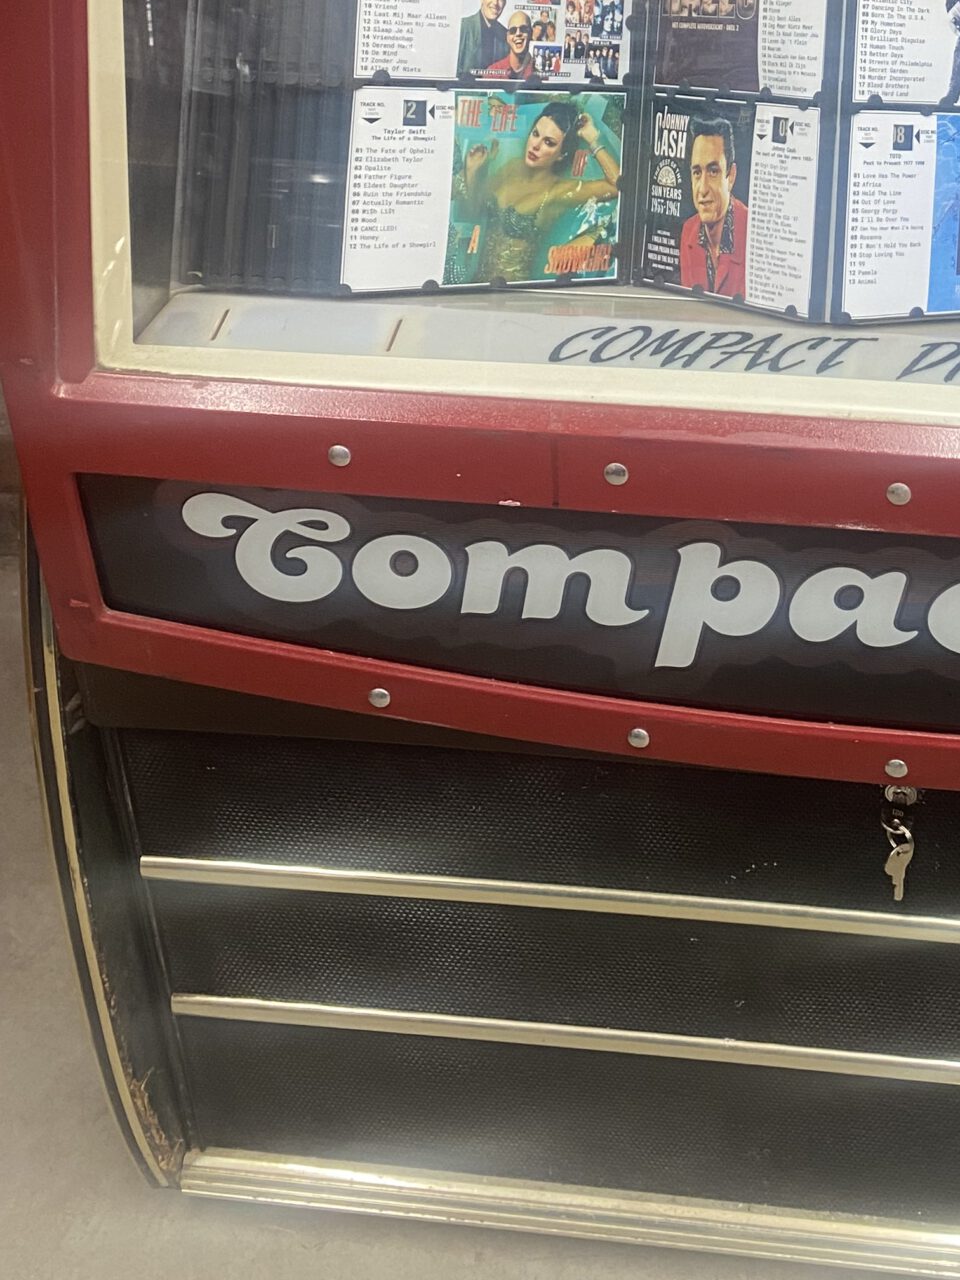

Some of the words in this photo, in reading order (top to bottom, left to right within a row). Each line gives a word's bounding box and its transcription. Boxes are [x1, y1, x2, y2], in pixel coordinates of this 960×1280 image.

[460, 99, 483, 128] THE
[491, 104, 519, 132] LIFE
[662, 105, 690, 132] JOHNNY
[654, 112, 687, 159] CASH
[572, 150, 589, 177] OF
[652, 184, 663, 196] SUN
[663, 187, 682, 200] YEARS
[651, 198, 681, 217] 1955-1961
[467, 224, 481, 253] A
[548, 325, 879, 375] COMPACT
